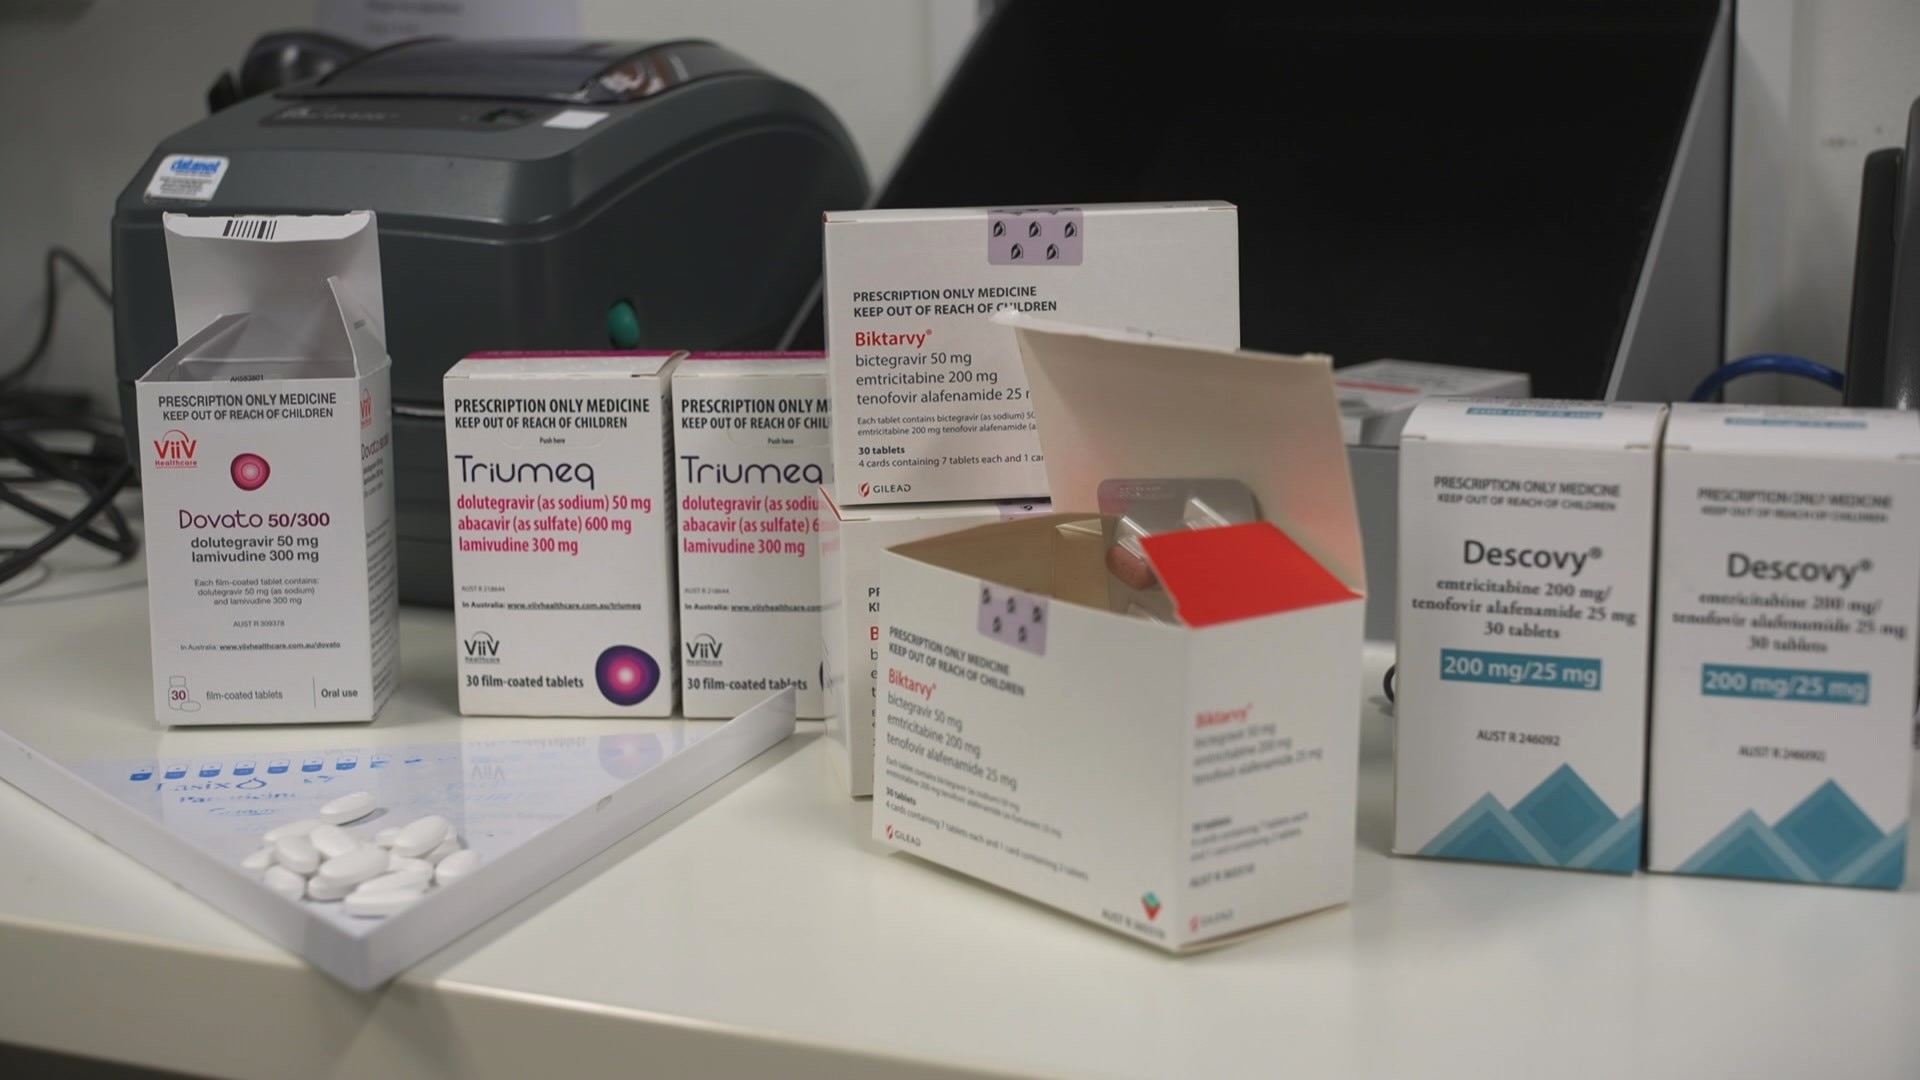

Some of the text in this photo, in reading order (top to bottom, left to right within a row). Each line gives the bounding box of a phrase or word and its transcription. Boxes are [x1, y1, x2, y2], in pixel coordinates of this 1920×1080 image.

[853, 287, 1037, 302] PRESCRIPTION ONLY MEDICINE
[856, 353, 971, 368] bictegravir 50 mg
[856, 371, 997, 386] emtricitabine 200 mg
[159, 393, 336, 407] PRESCRIPTION ONLY MEDICINE
[857, 392, 917, 404] tenofovir
[921, 389, 1002, 403] alafenamide
[1006, 389, 1021, 399] 25
[455, 399, 649, 412] PRESCRIPTION ONLY MEDICINE
[682, 399, 774, 413] PRESCRIPTION
[779, 400, 813, 413] ONLY
[163, 408, 333, 420] KEEP OUT OF REACH OF CHILDREN
[937, 414, 978, 422] bictegravir
[981, 413, 991, 422] (as
[993, 413, 1024, 421] sodium)
[456, 417, 627, 428] KEEP OUT OF REACH OF CHILDREN
[154, 440, 197, 459] ViiV
[859, 447, 870, 455] 30
[866, 459, 889, 467] cards
[892, 457, 939, 467] containing
[950, 456, 979, 464] tablets
[455, 455, 594, 490] Triumeq
[873, 484, 911, 493] GILEAD
[1434, 476, 1620, 497] PRESCRIPTION ONLY MEDICINE
[457, 495, 651, 513] dolutegravir (as sodium) 50 mg
[1437, 493, 1615, 511] KEEP OUT OF REACH OF CHILDREN
[179, 510, 330, 529] Dovato 50/300
[458, 517, 631, 534] abacavir (as sulfate) 600 mg
[683, 517, 736, 532] abacavir
[739, 518, 757, 533] (as
[760, 518, 809, 533] sulfate)
[191, 536, 318, 550] dolutegravir 50 mg
[460, 538, 578, 555] lamivudine 300 mg
[684, 538, 805, 557] lamivudine 300 mg
[192, 551, 319, 563] lamivudine 300 mg
[216, 578, 258, 586] film-coated
[284, 577, 319, 585] contains:
[198, 588, 242, 596] dolutegravir
[284, 587, 314, 595] sodium)
[1437, 579, 1612, 603] emtricitabine 200 mg/
[230, 597, 271, 605] lamivudine
[1413, 597, 1636, 625] tenofovir alafenamide 25 mg
[1485, 622, 1560, 638] 30 tablets
[464, 640, 499, 655] ViiV
[687, 642, 722, 658] ViiV
[890, 627, 943, 653] PRESCRIPTION
[944, 646, 965, 660] ONLY
[968, 654, 1009, 675] MEDICINE
[1444, 657, 1597, 687] 200 mg/25 mg
[466, 675, 583, 687] 30 film-coated tablets
[1706, 671, 1865, 700] 200 mg/25 mg
[171, 691, 282, 701] 30 film-coated tablets
[321, 689, 339, 698] Oral
[888, 691, 963, 733] bictegravir 50 mg
[1477, 730, 1560, 746] AUST R 246092
[895, 830, 921, 846] GILEAD
